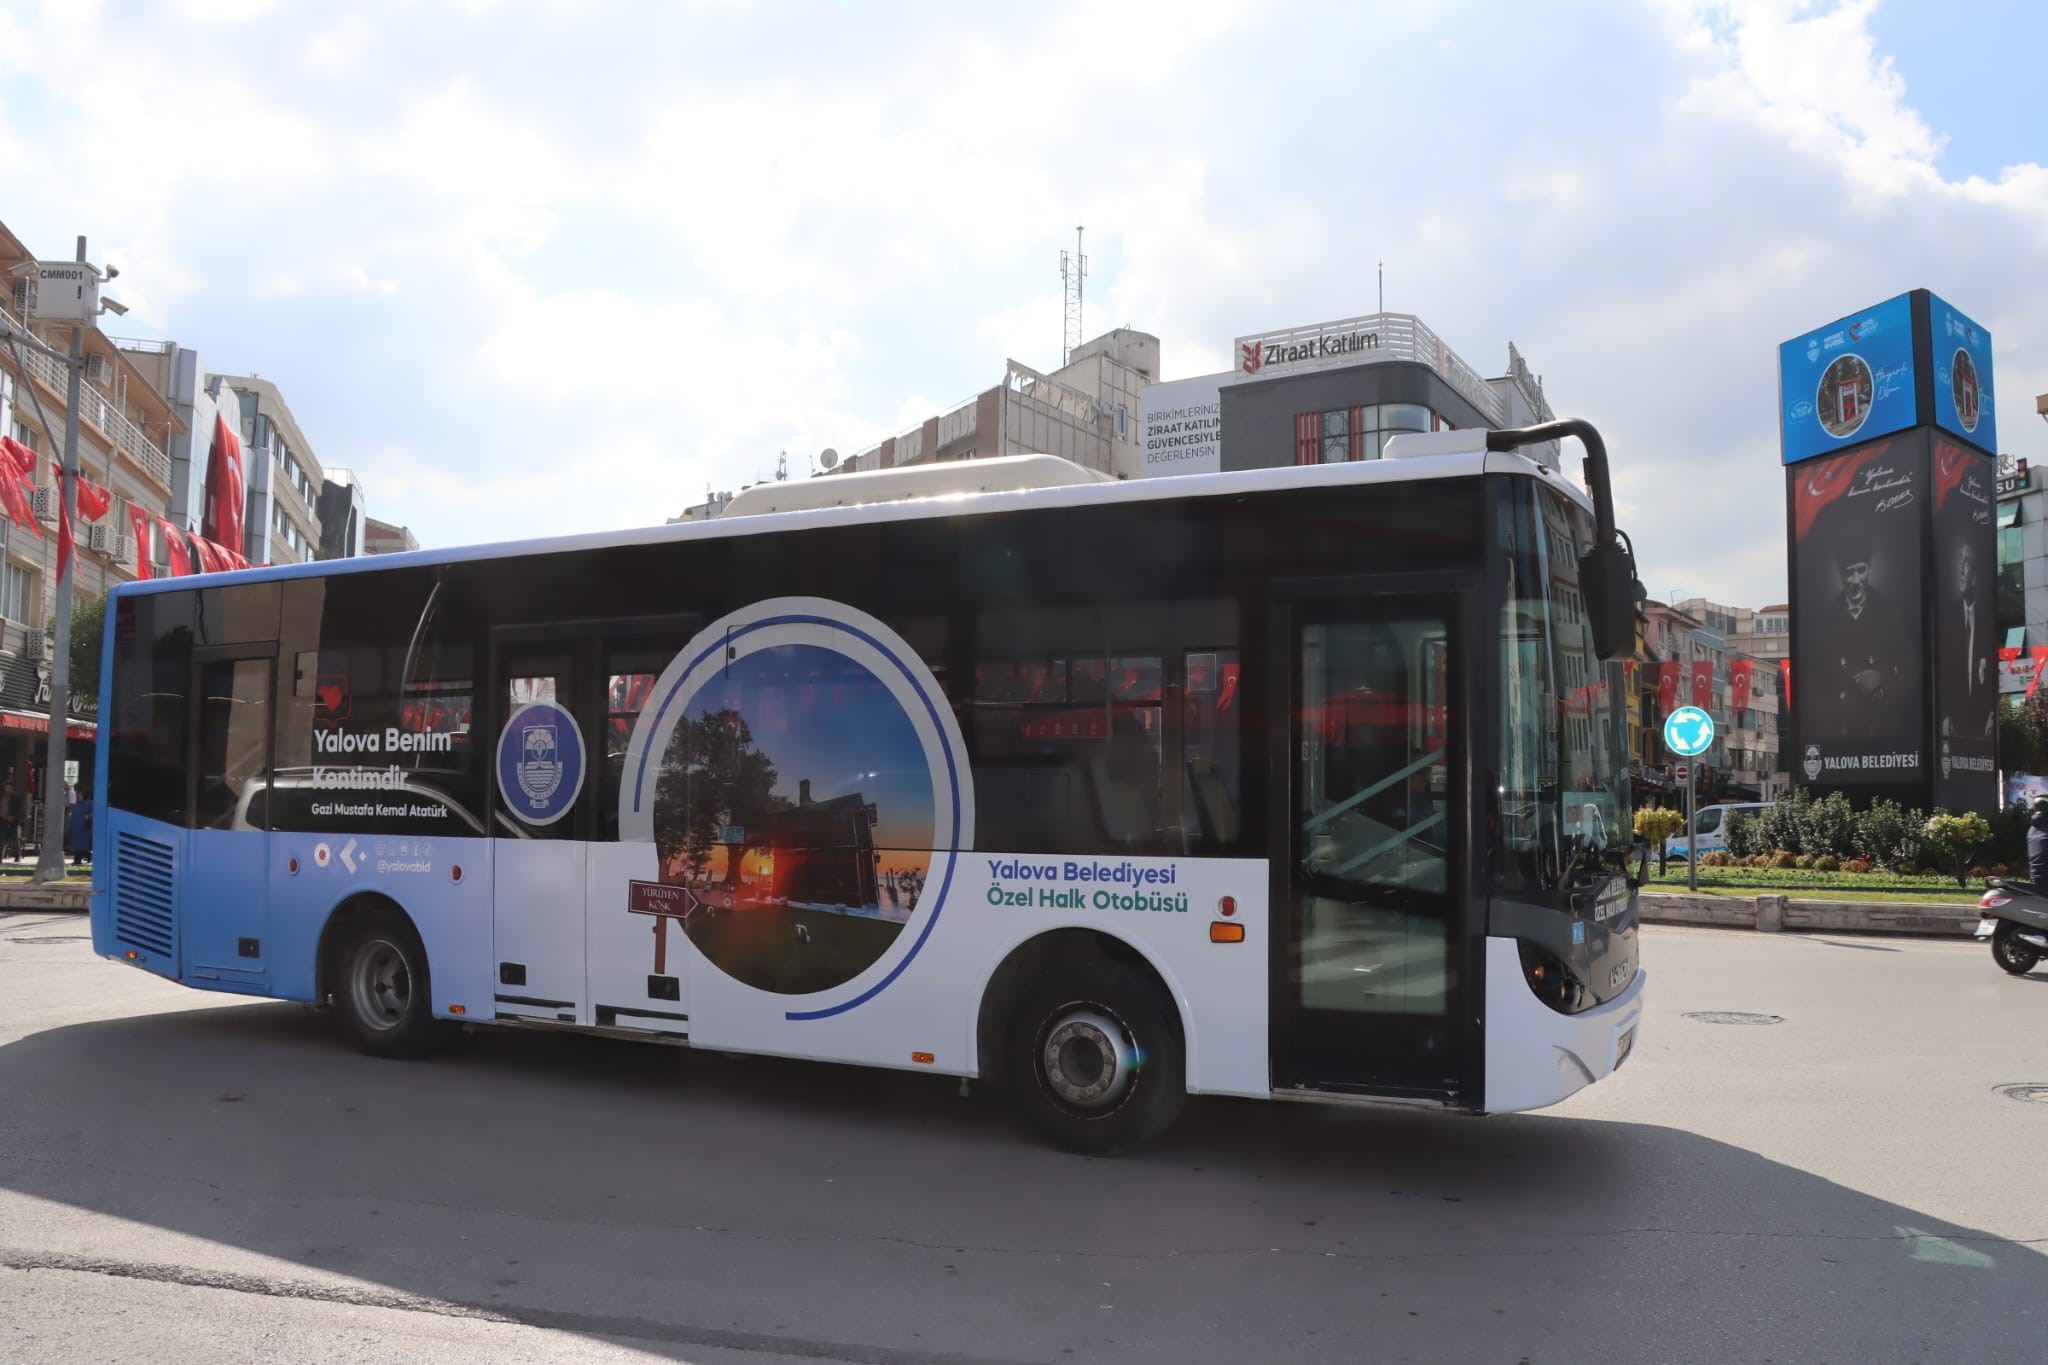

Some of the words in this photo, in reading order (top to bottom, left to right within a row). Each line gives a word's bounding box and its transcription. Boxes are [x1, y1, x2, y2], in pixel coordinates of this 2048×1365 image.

[40, 270, 83, 280] CMM001
[1264, 339, 1316, 365] Ziraat
[1318, 332, 1378, 358] Katılım
[1147, 422, 1182, 437] ZİRAAT
[314, 727, 379, 753] Yalova
[385, 727, 451, 752] Benim
[1824, 756, 1859, 769] YALOVA
[1862, 750, 1918, 768] BELEDİYESİ
[312, 803, 333, 815] Gazi
[334, 803, 374, 816] Mustafa
[376, 804, 407, 817] Kemal
[409, 805, 447, 818] Atatürk
[377, 860, 431, 873] @yalovabld
[988, 859, 1057, 881] Yalova
[1063, 861, 1176, 888] Belediyesi
[987, 882, 1033, 907] Özel
[1039, 888, 1086, 909] Halk
[1092, 889, 1188, 912] Otobüsü
